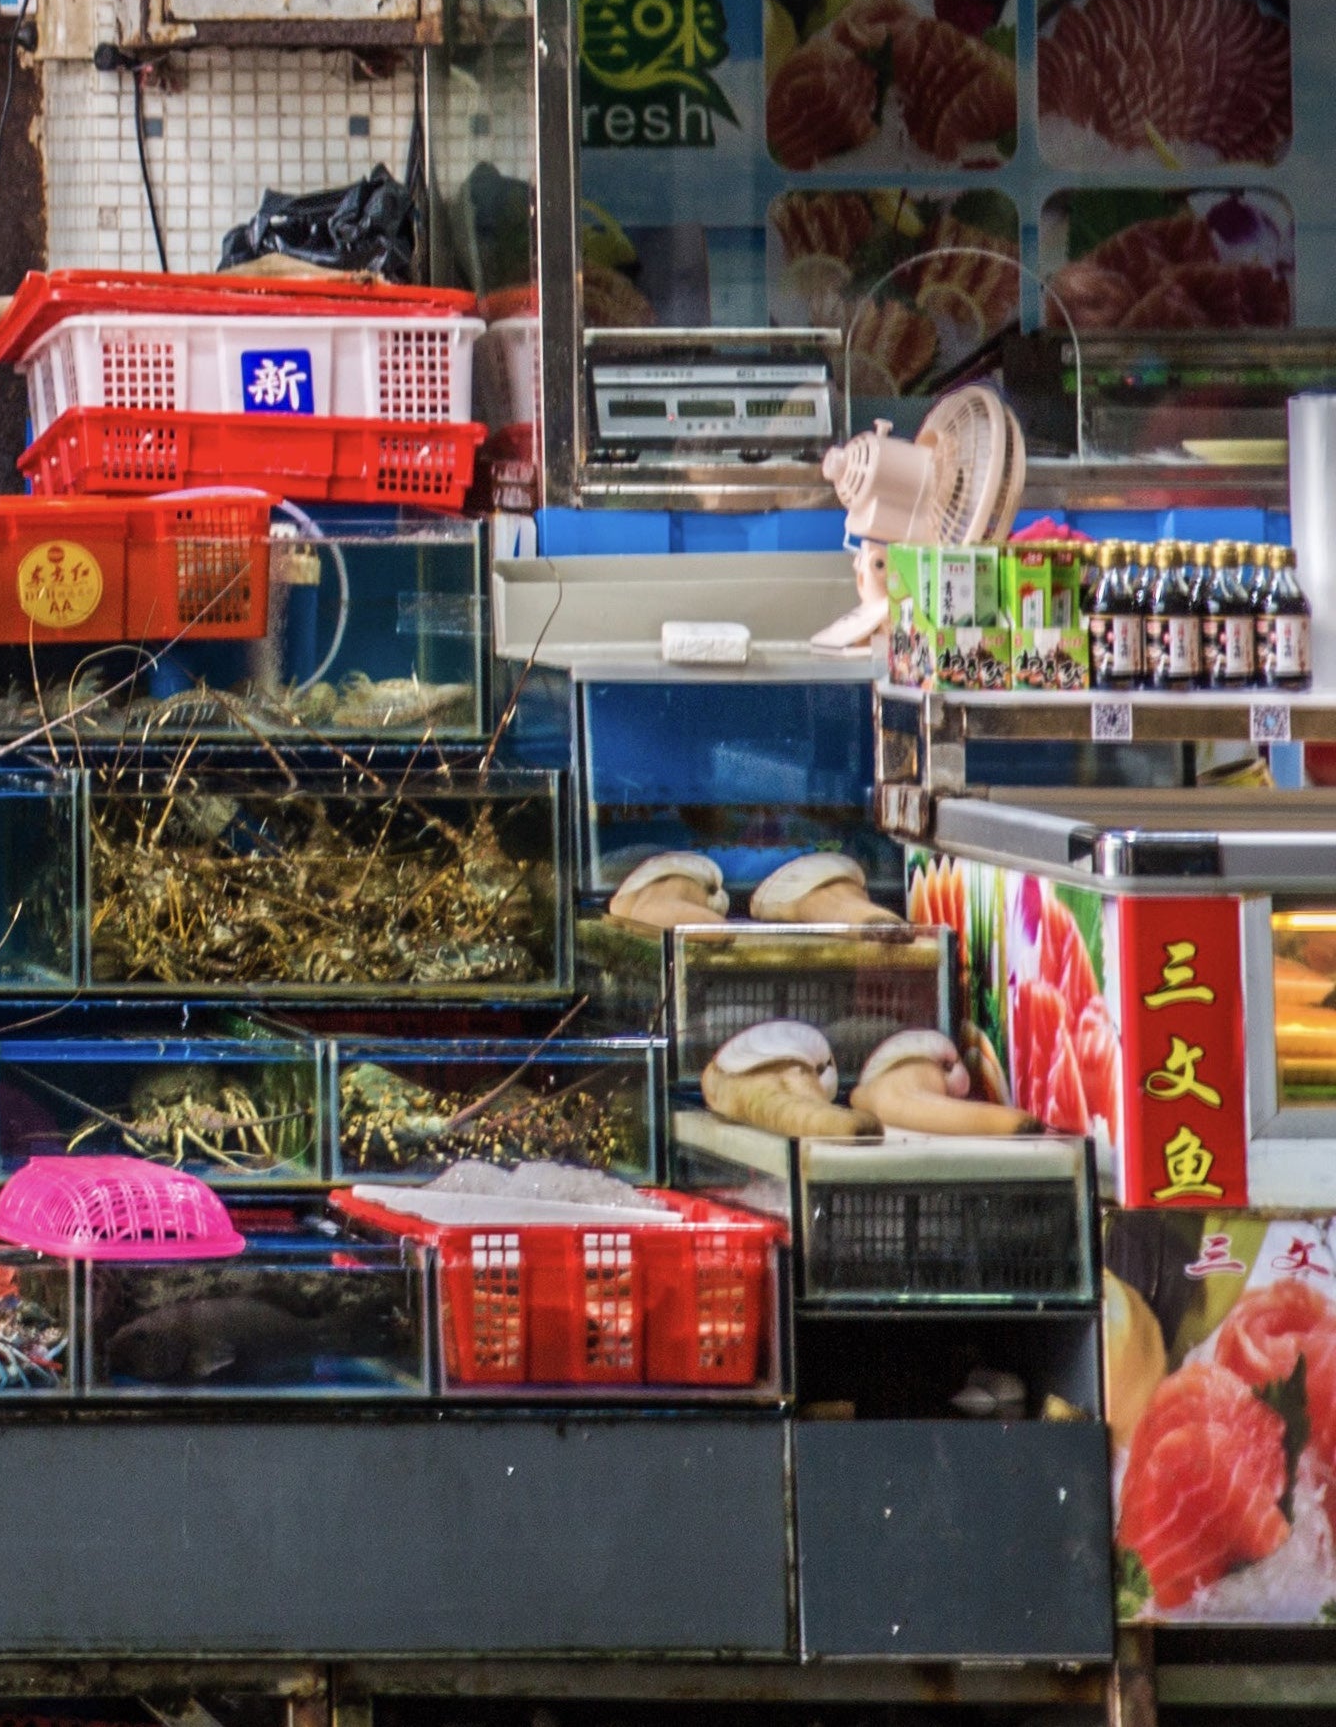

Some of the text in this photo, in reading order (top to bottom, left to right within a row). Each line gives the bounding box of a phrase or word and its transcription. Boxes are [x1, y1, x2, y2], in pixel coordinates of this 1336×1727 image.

[247, 358, 307, 411] 新
[49, 599, 73, 614] AA
[1143, 941, 1224, 1201] 三文鱼
[1185, 1235, 1329, 1276] 三文
